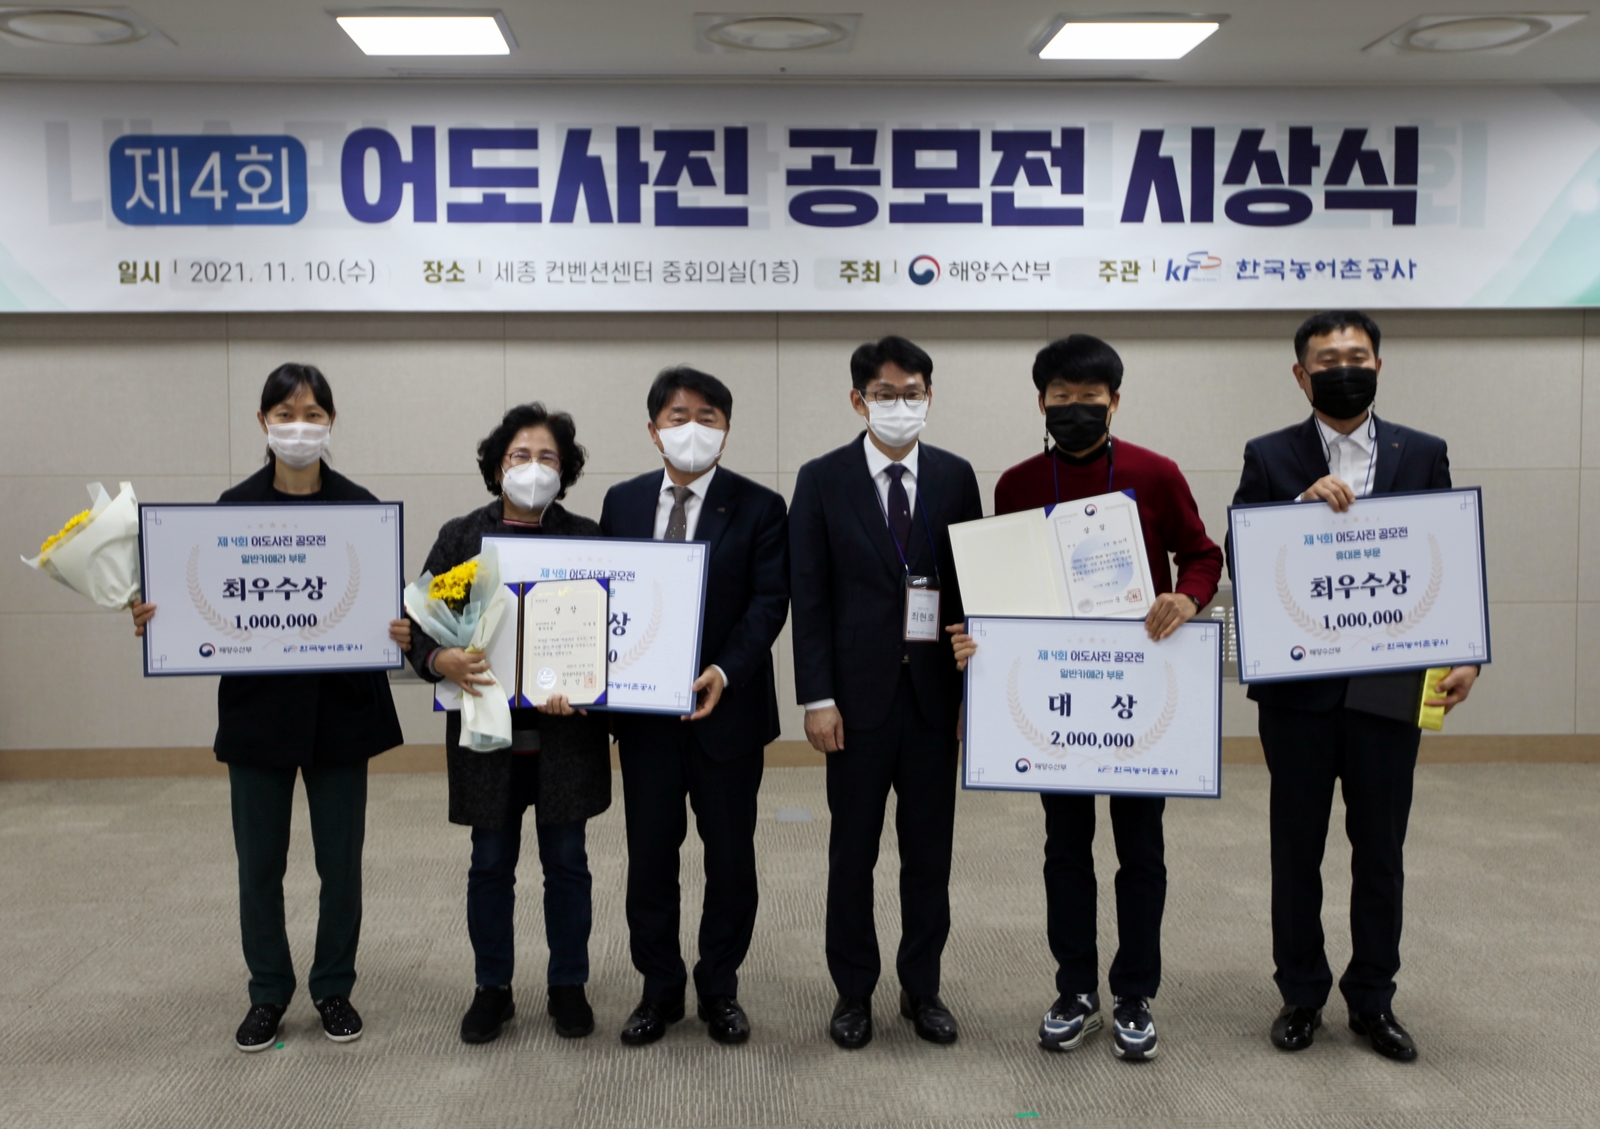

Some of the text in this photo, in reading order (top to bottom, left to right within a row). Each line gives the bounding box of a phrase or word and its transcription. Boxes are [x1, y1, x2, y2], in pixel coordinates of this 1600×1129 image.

[125, 145, 291, 214] 제4회
[341, 125, 749, 227] 어도사진
[785, 126, 1084, 227] 공모전
[1120, 125, 1419, 227] 시상식
[118, 259, 374, 284] 일시 2021. 11. 10.(수)
[424, 260, 798, 284] 장소 세종 컨벤션센터 중회의실(1층)
[840, 260, 1050, 283] 주최 해양수산부
[1099, 261, 1140, 282] 주관
[1237, 258, 1417, 280] 한국농어촌공사
[217, 537, 228, 547] 제
[251, 536, 292, 546] 어도사진
[296, 535, 326, 546] 공모전
[1303, 535, 1314, 545] 제
[1336, 530, 1376, 542] 어도사진
[1379, 527, 1408, 540] 공모전
[241, 554, 306, 564] 일반카메라 부문
[1336, 548, 1380, 560] 휴대폰 부문
[609, 571, 635, 581] 공모전
[1311, 569, 1410, 600] 최우수상
[222, 576, 327, 601] 최우수상
[235, 613, 317, 630] 1,000,000
[1323, 609, 1403, 630] 1,000,000
[1038, 650, 1048, 660] 제
[1071, 651, 1110, 662] 어도사진
[1114, 652, 1144, 663] 공모전
[1060, 669, 1123, 680] 일반카메라 부문
[1048, 692, 1137, 719] 대 상
[1051, 731, 1134, 748] 2,000,000
